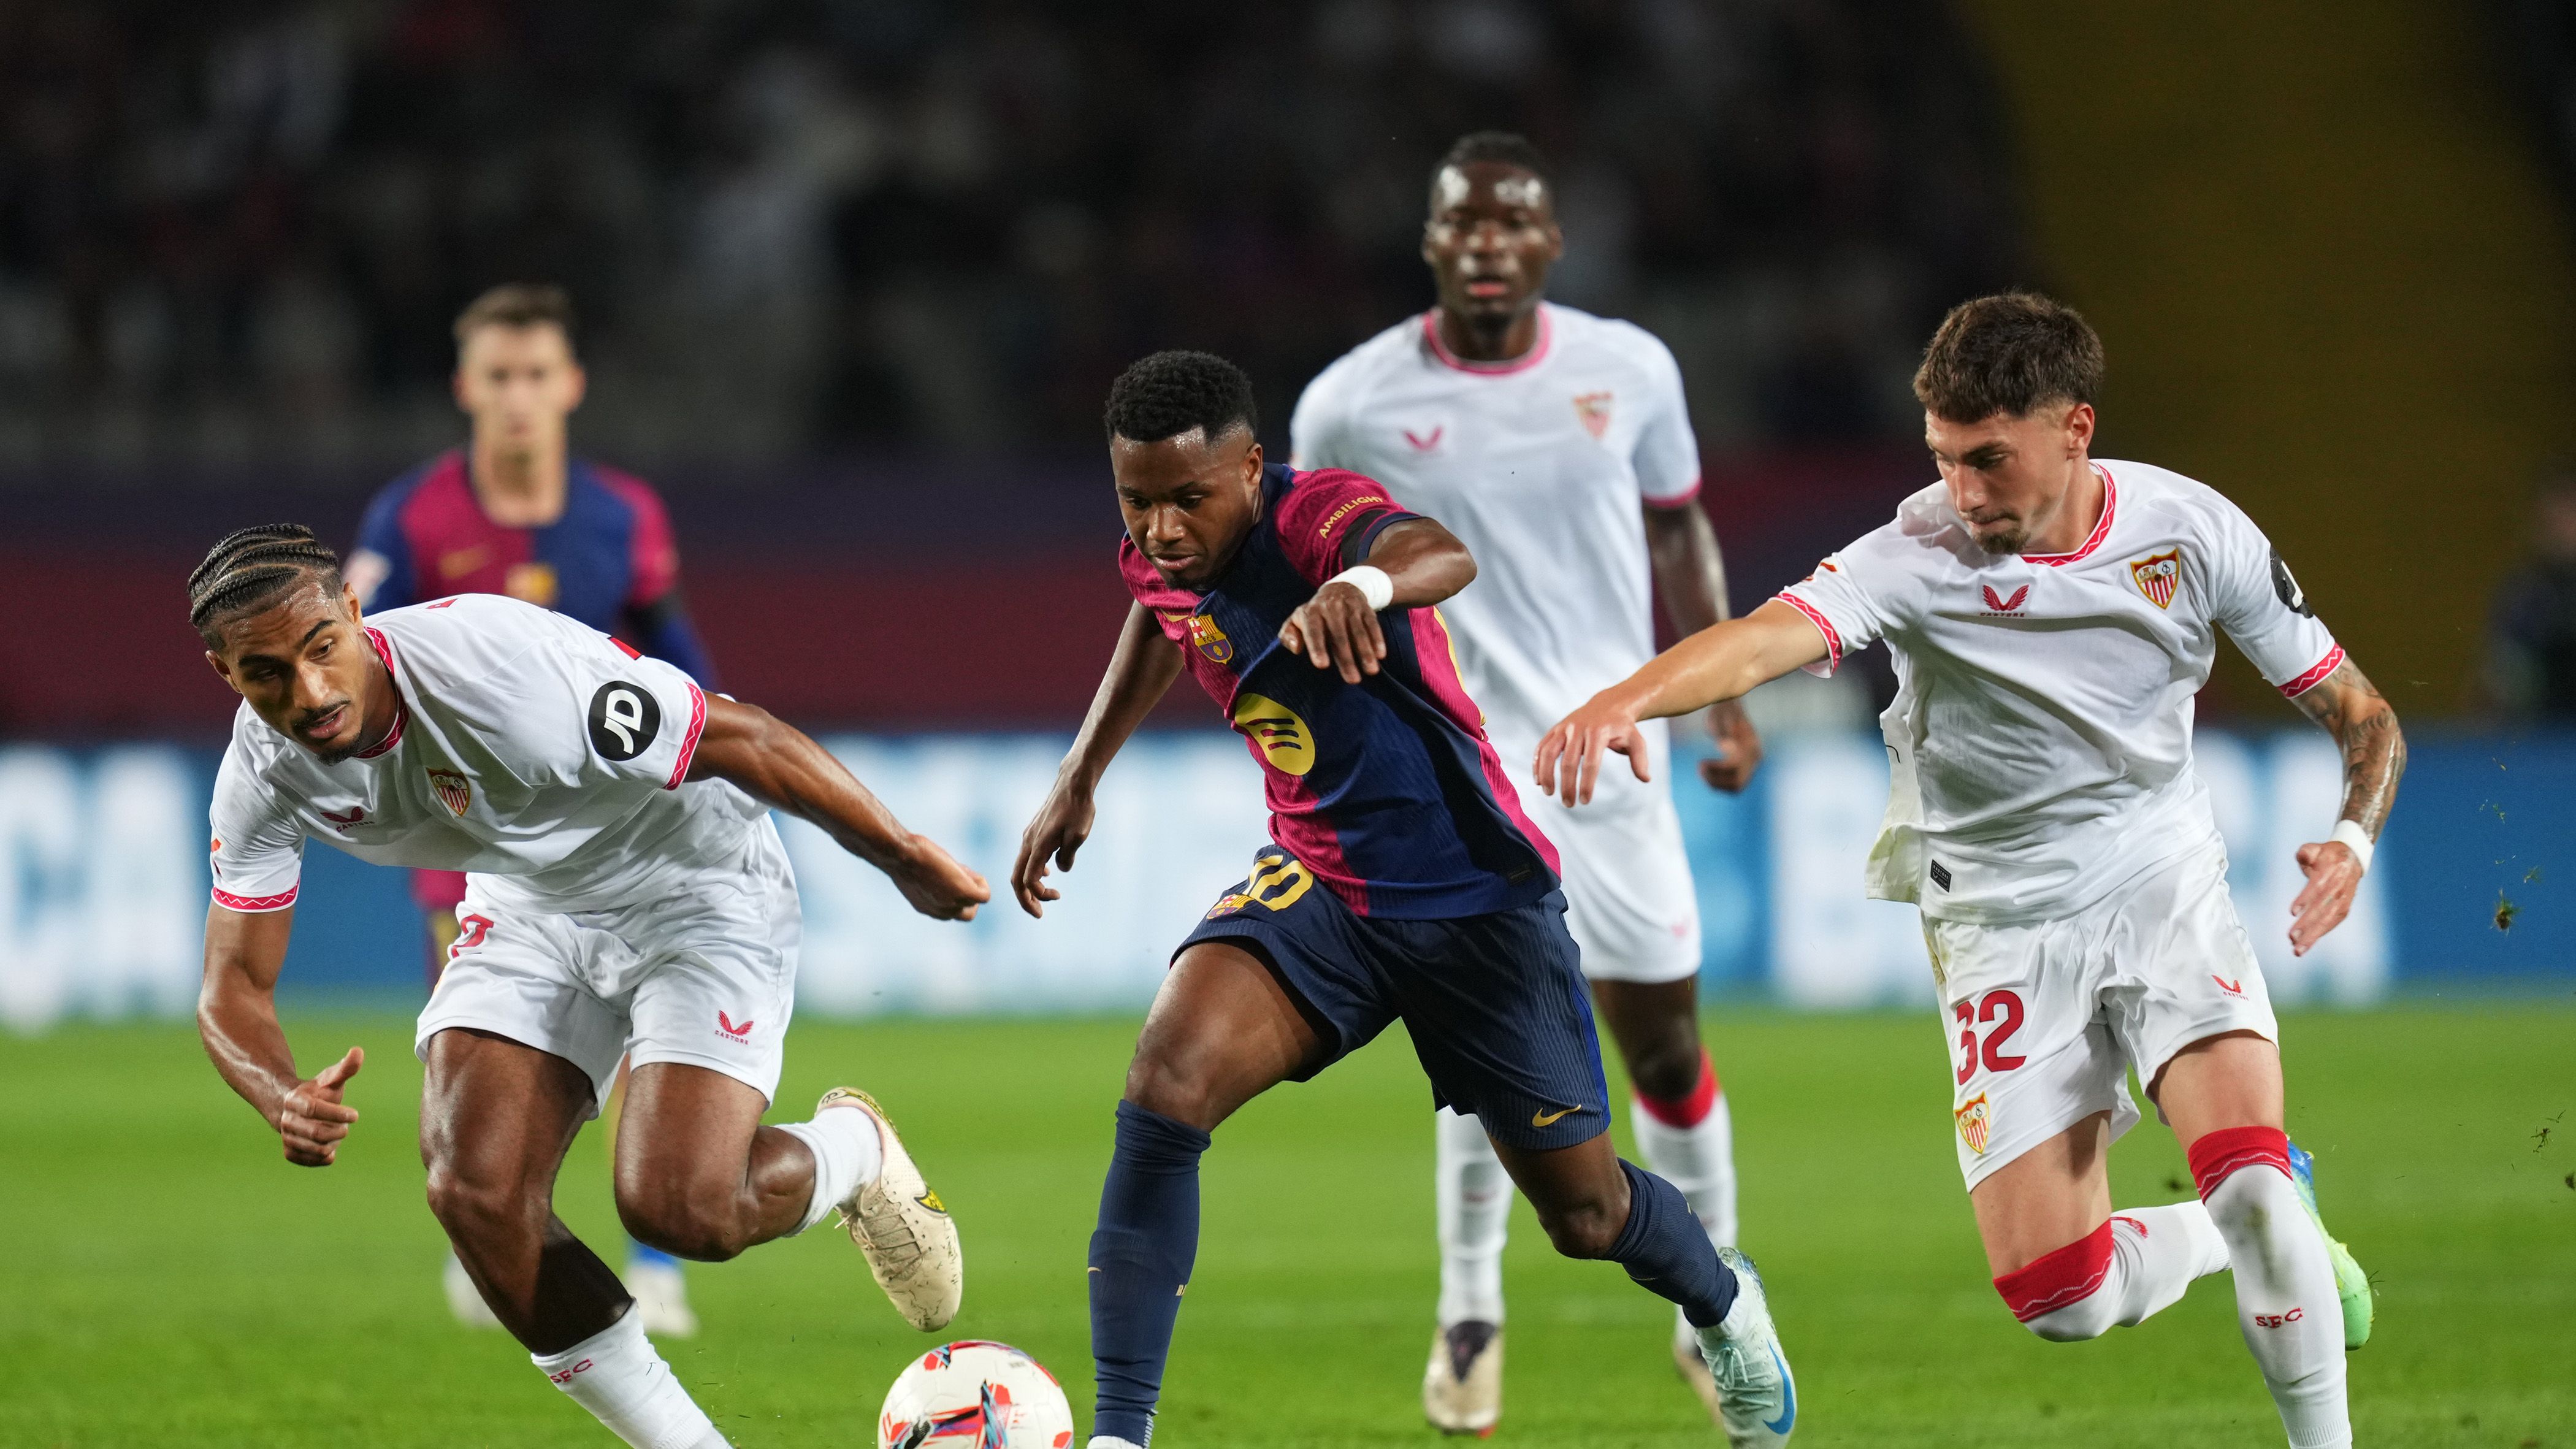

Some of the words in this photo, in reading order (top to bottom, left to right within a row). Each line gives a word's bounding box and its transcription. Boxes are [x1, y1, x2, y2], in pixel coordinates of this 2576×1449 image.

[603, 689, 643, 754] JD
[1957, 990, 2027, 1085] 32
[2255, 1307, 2303, 1329] SFC
[549, 1358, 594, 1383] SFC
